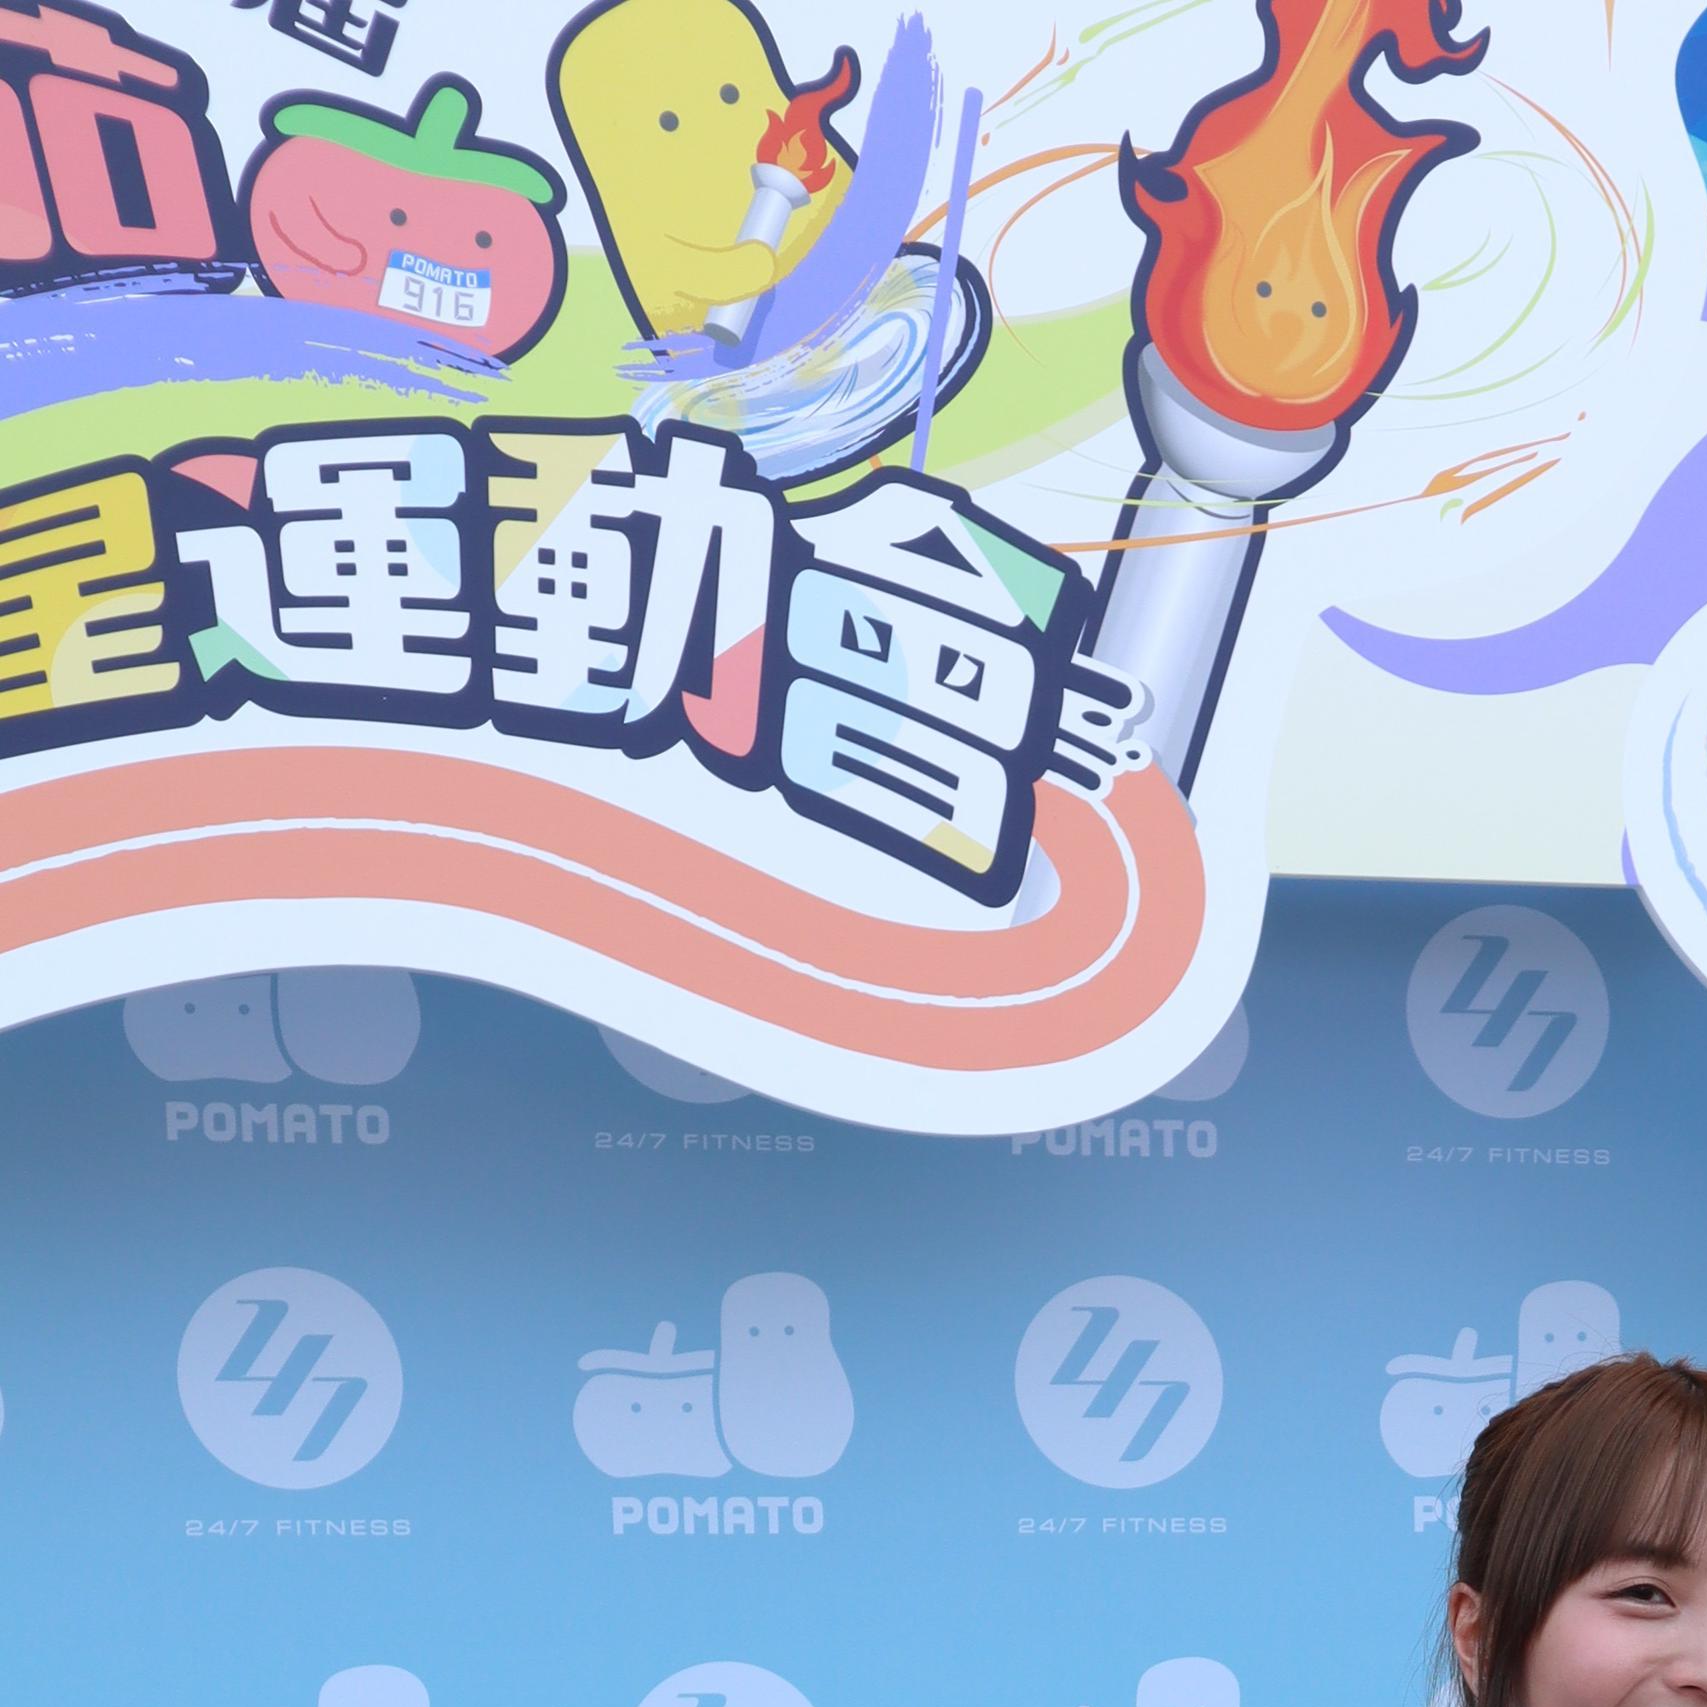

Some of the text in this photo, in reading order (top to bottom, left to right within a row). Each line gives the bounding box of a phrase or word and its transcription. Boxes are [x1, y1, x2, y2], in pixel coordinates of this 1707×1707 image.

[402, 253, 478, 289] POMATO
[402, 275, 475, 321] 916
[166, 1102, 389, 1144] POMATO
[595, 1132, 815, 1152] 24/7 FITNESS
[1407, 1146, 1610, 1165] 24/7 FITNESS
[186, 1519, 411, 1536] 24/7 FITNESS
[613, 1497, 823, 1534] POMATO
[1019, 1517, 1227, 1534] 24/7 FITNESS
